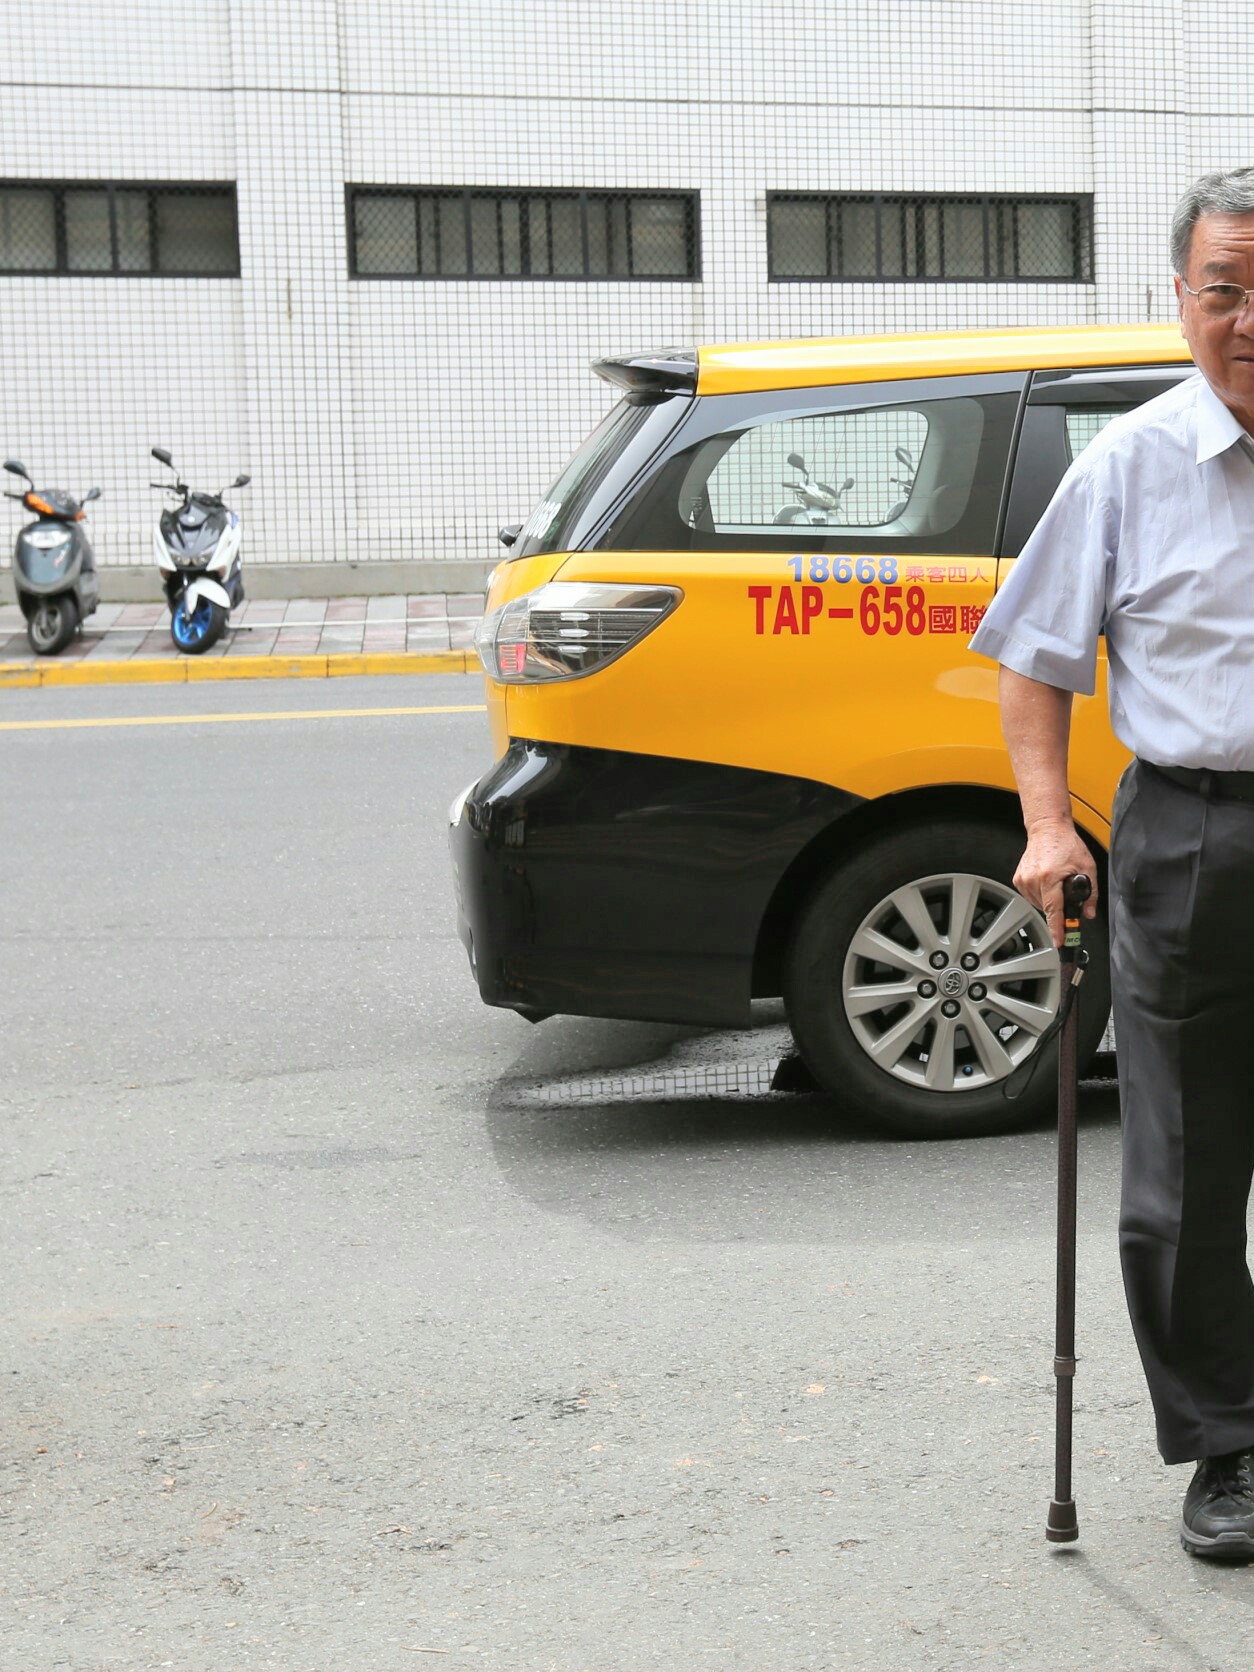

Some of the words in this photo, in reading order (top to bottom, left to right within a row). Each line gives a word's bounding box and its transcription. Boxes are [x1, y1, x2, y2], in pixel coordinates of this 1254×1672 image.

[787, 555, 899, 585] 18668
[905, 565, 990, 584] 乘客四人
[748, 585, 926, 636] TAP-658
